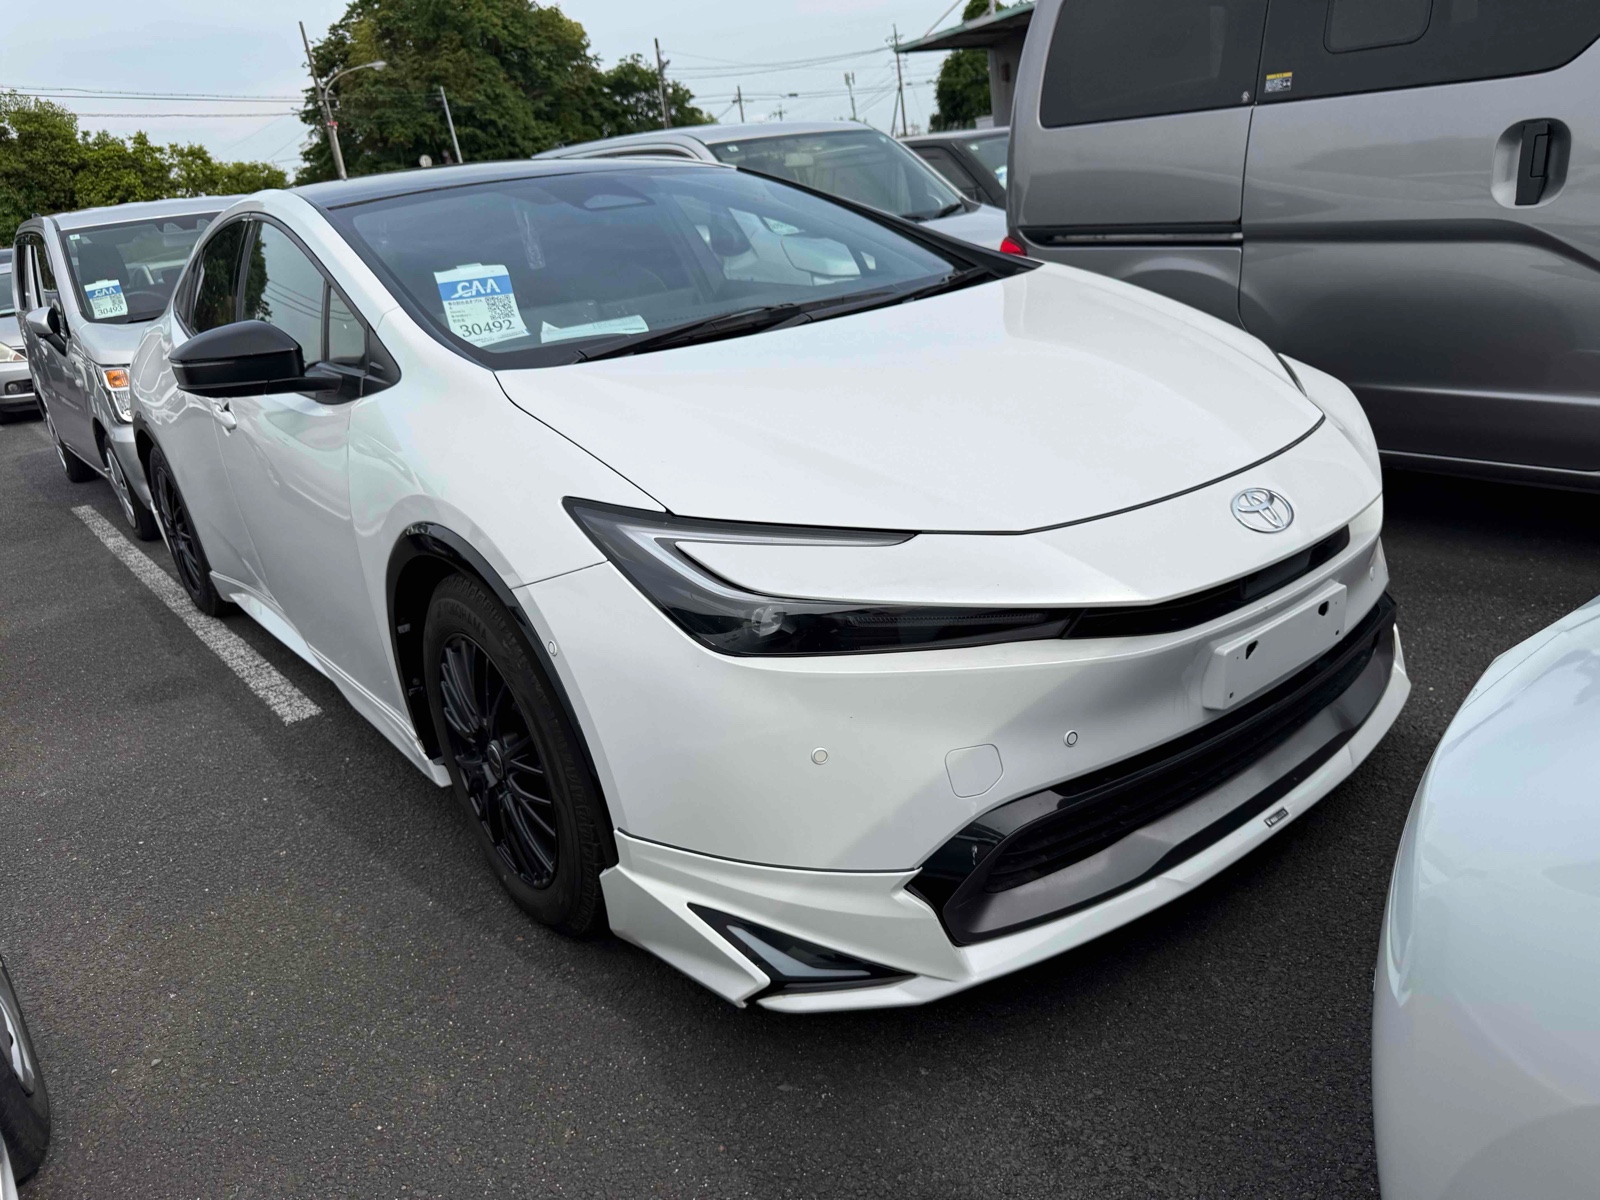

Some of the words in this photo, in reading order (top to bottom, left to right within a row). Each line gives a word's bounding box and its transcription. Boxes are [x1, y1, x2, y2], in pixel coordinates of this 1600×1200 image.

[93, 287, 117, 298] CAA
[451, 278, 501, 298] CAA
[97, 305, 123, 316] 30493
[460, 319, 515, 338] 30492
